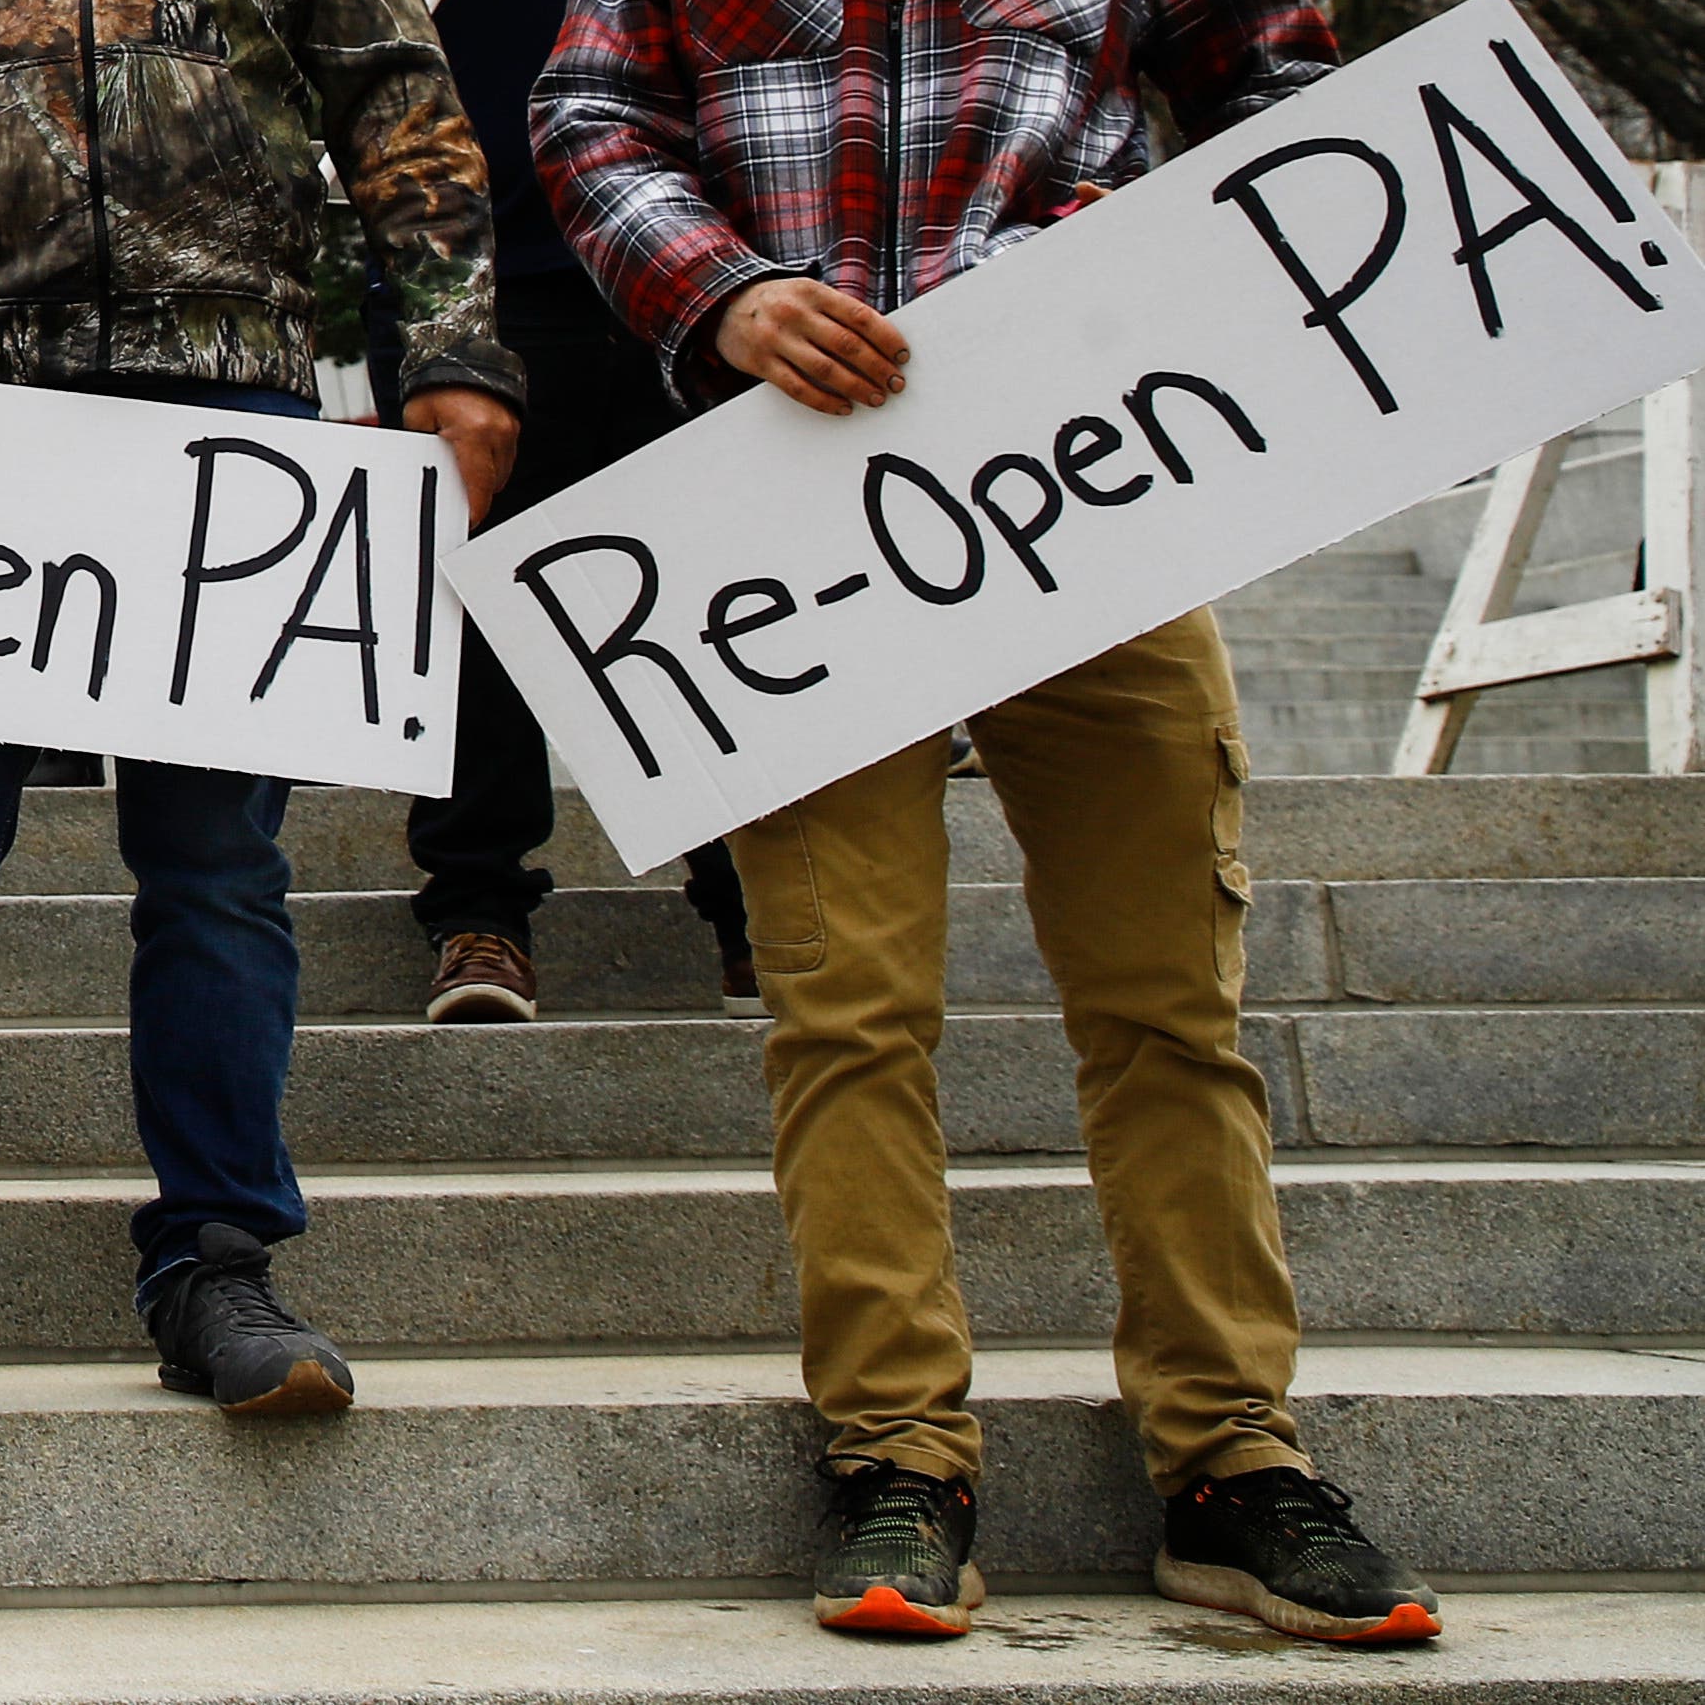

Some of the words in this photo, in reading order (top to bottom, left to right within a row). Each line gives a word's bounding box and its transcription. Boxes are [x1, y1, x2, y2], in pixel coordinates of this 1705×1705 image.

[168, 436, 438, 742] PA!
[514, 370, 1267, 779] Re-Open
[1212, 38, 1668, 415] PA!
